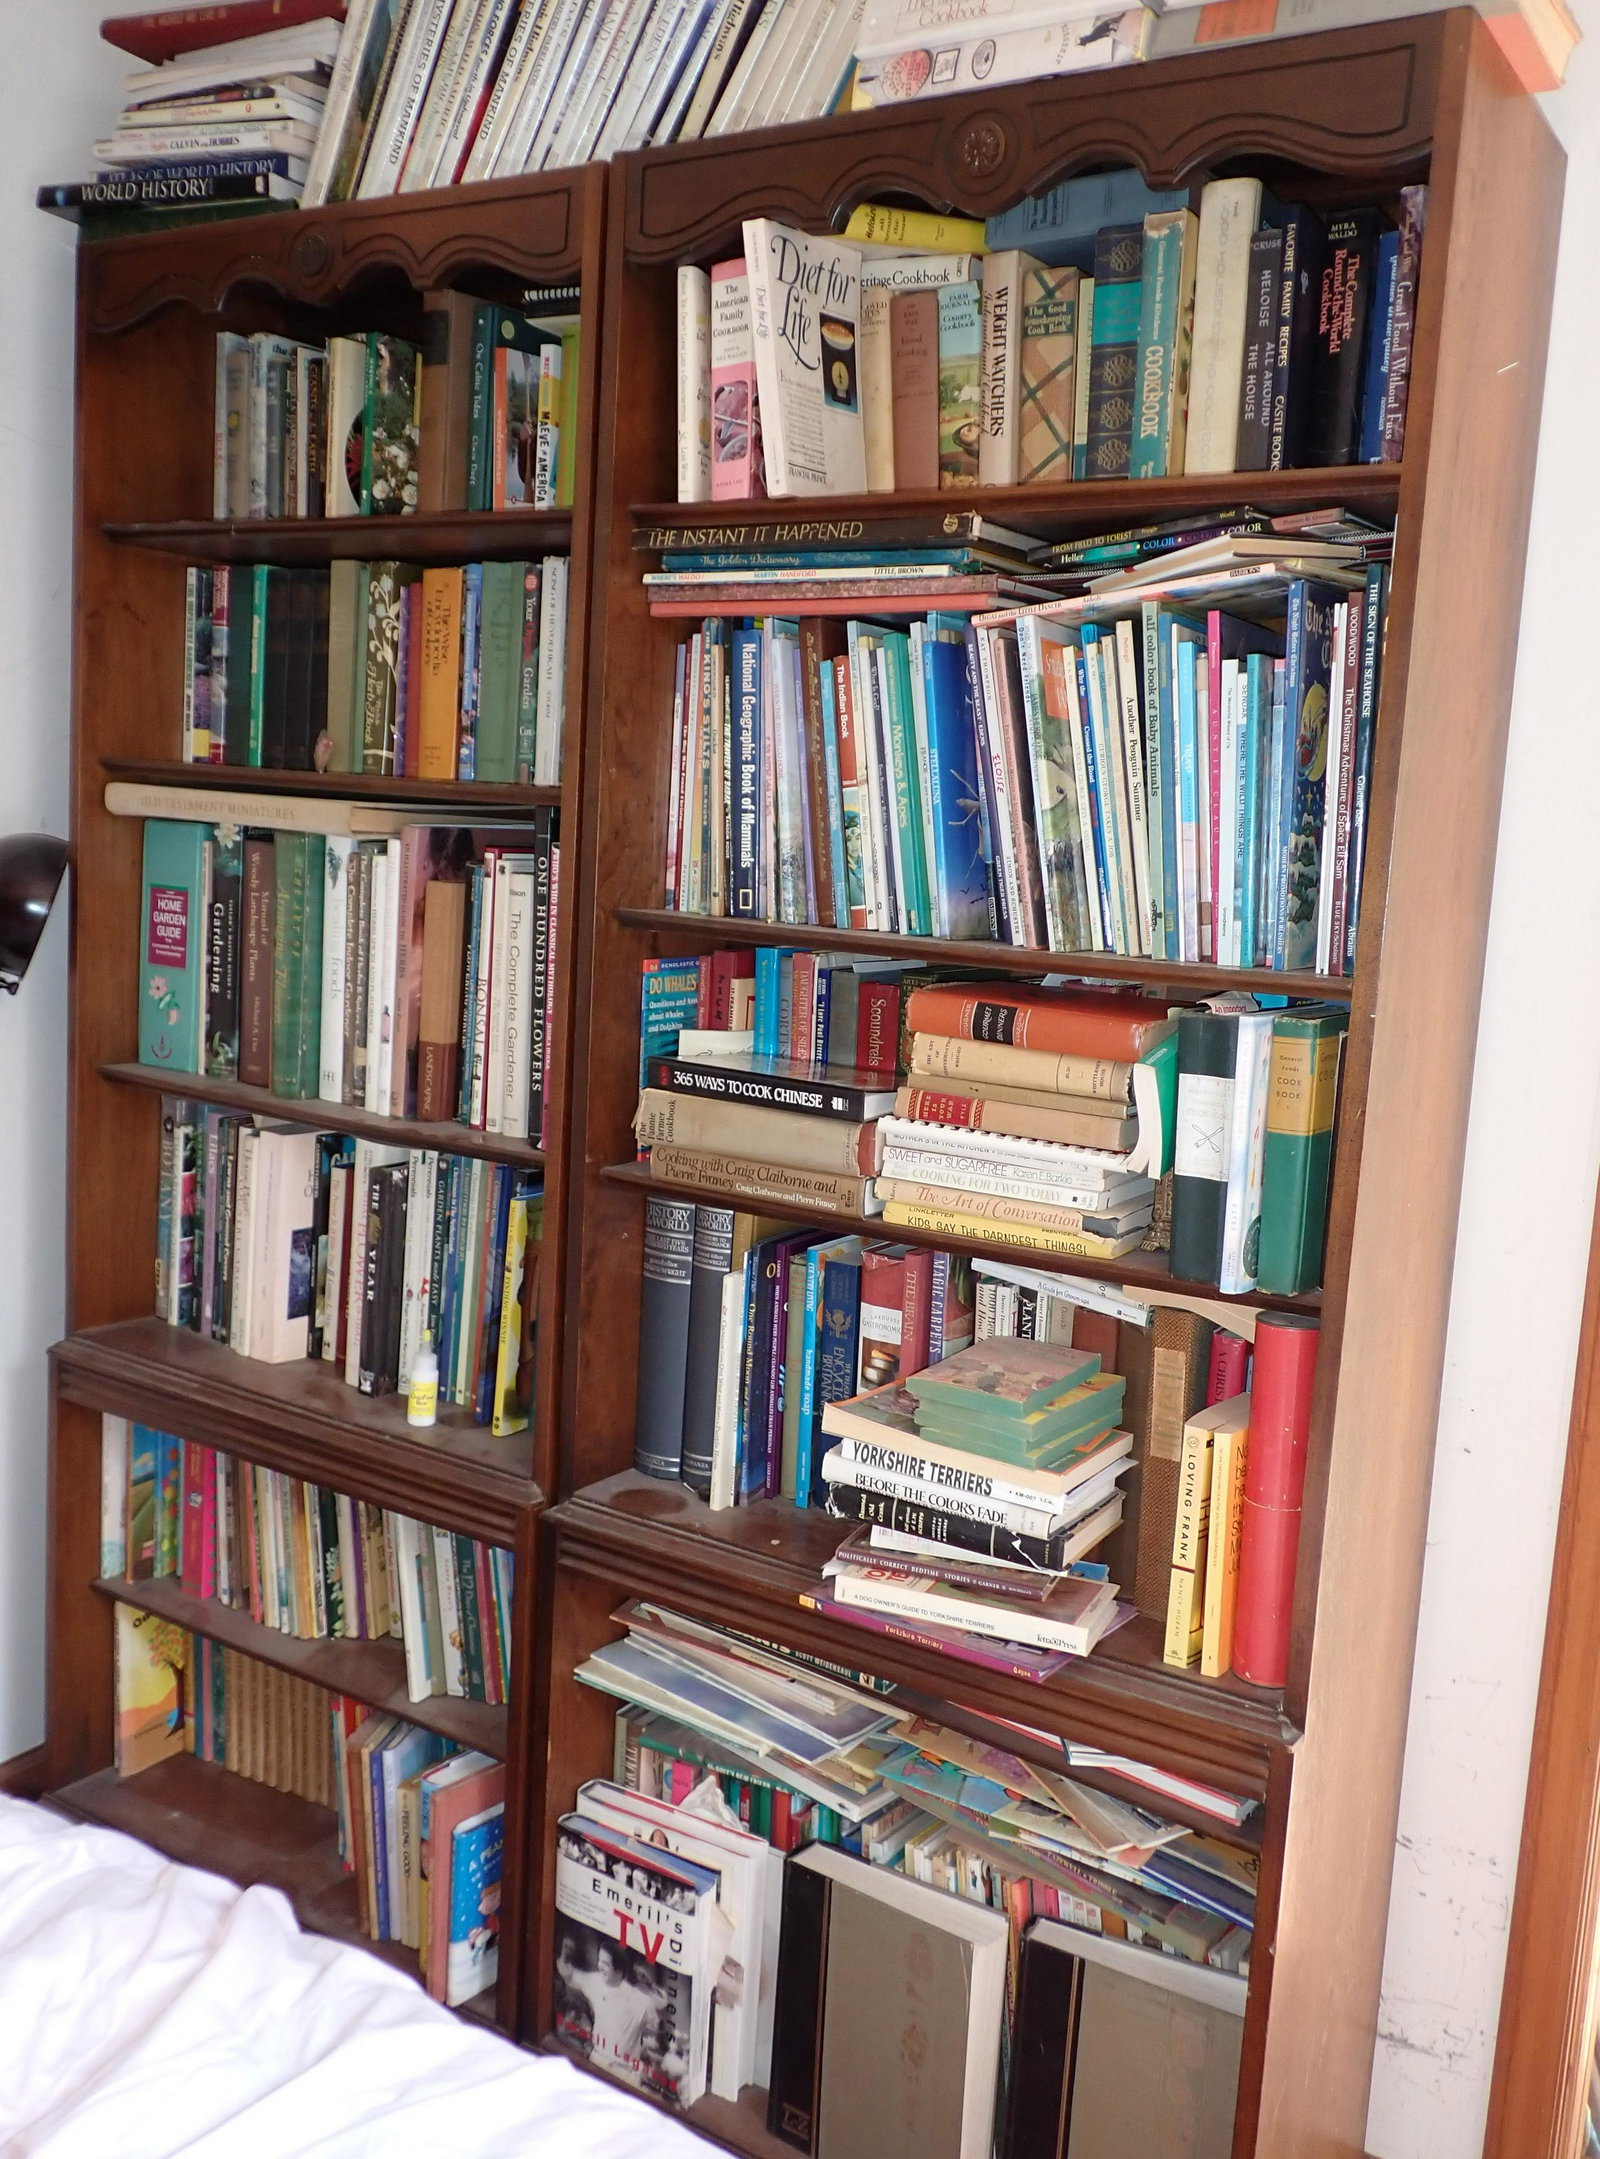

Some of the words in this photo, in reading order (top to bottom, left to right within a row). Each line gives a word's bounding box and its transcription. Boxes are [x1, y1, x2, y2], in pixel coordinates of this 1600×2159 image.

[418, 0, 447, 71] YSTERIES
[412, 73, 421, 92] OF
[390, 97, 415, 164] MANKIND
[81, 182, 136, 201] WORLD
[142, 178, 209, 199] HISTORY
[1328, 230, 1357, 240] WALDO
[1331, 221, 1355, 231] MYRA
[1284, 224, 1296, 272] FAVORITE
[1349, 255, 1360, 276] The
[725, 284, 739, 295] The
[771, 235, 826, 296] Diet
[823, 256, 856, 309] for
[714, 295, 749, 309] American
[720, 309, 744, 322] Family
[1028, 306, 1044, 317] The
[1048, 303, 1067, 314] Good
[1260, 269, 1271, 327] HELOISE
[1282, 281, 1292, 317] FAMILY
[1319, 268, 1333, 335] Cookbook
[1342, 280, 1357, 340] Complete
[1396, 281, 1413, 318] Great
[777, 286, 821, 371] Life
[992, 286, 1008, 354] WEIGHT
[1027, 325, 1045, 335] Cook
[1048, 323, 1067, 333] Book
[1393, 321, 1409, 355] Food
[1248, 343, 1258, 369] THE
[1266, 342, 1275, 365] ALL
[1279, 326, 1289, 367] RECIPES
[990, 355, 1006, 437] WATCHERS
[1141, 346, 1164, 439] COOKBOOK
[1245, 375, 1257, 420] HOUSE
[1262, 370, 1273, 426] AROUND
[1389, 357, 1407, 408] Without
[539, 411, 550, 447] MAEVE
[1274, 395, 1285, 432] CASTLE
[1386, 413, 1401, 440] Fuss
[1271, 433, 1282, 471] BOOKS
[536, 457, 548, 503] AMERICA
[649, 530, 677, 547] THE
[682, 526, 748, 545] INSTANT
[753, 525, 769, 542] IT
[775, 522, 863, 540] HAPPENED
[1052, 542, 1071, 554] FROM
[1073, 538, 1093, 550] FIELD
[1094, 536, 1105, 546] TO
[1106, 531, 1133, 544] FOREST
[700, 554, 715, 566] The
[718, 553, 748, 567] Golden
[750, 552, 800, 567] Dictionary
[1061, 552, 1084, 563] Heller
[1369, 582, 1378, 604] THE
[1146, 614, 1154, 632] all
[1368, 605, 1377, 630] SIGN
[1147, 636, 1156, 661] color
[1367, 631, 1375, 645] OF
[742, 642, 756, 691] National
[837, 665, 845, 680] The
[1365, 647, 1374, 667] THE
[703, 654, 711, 708] KING'S
[1148, 663, 1156, 694] book
[1362, 669, 1372, 718] SEAHORSE
[838, 682, 847, 713] Indian
[1126, 696, 1135, 735] Another
[1149, 697, 1158, 710] of
[702, 712, 710, 769] STILTS
[740, 696, 755, 760] Geographic
[841, 714, 849, 739] Book
[1149, 713, 1159, 741] Baby
[892, 725, 903, 781] Monkeys
[1129, 737, 1139, 778] Penguin
[1150, 743, 1159, 798] Animals
[741, 764, 755, 794] Book
[896, 782, 905, 796] &
[992, 753, 1005, 794] ELOISE
[165, 798, 225, 814] TESTAMENT
[227, 802, 296, 819] MINIATURES
[741, 798, 754, 811] of
[898, 798, 907, 828] Apes
[1132, 781, 1141, 822] Summer
[741, 814, 754, 868] Mammals
[536, 856, 547, 894] ONE
[153, 912, 187, 924] GARDEN
[158, 898, 181, 911] HOME
[157, 925, 181, 938] GUIDE
[509, 910, 522, 940] The
[211, 901, 224, 994] Gardening
[532, 903, 546, 998] HUNDRED
[507, 944, 520, 1023] Complete
[650, 977, 662, 994] DO
[664, 975, 697, 993] WHALES
[475, 978, 488, 1043] BONSAI
[982, 1006, 993, 1041] GOURMET
[995, 1008, 1008, 1042] DINNERS
[530, 1007, 545, 1092] FLOWERS
[868, 998, 886, 1067] Scoundrels
[505, 1025, 518, 1100] Gardener
[674, 1072, 693, 1086] 365
[694, 1077, 725, 1092] WAYS
[727, 1081, 742, 1094] TO
[742, 1084, 772, 1101] COOK
[774, 1088, 823, 1109] CHINESE
[1277, 1077, 1302, 1086] COOK
[656, 1112, 665, 1141] Farmer
[665, 1100, 676, 1143] Cookbook
[410, 1156, 418, 1198] Perennials
[656, 1148, 700, 1170] Cooking
[700, 1158, 724, 1173] with
[725, 1162, 757, 1184] Craig
[757, 1168, 811, 1189] Claiborne
[812, 1180, 837, 1194] and
[370, 1184, 380, 1210] THE
[435, 1180, 445, 1219] GARDEN
[909, 1206, 955, 1218] LINKLETTER
[916, 1186, 942, 1204] The
[943, 1192, 973, 1209] Art
[975, 1197, 990, 1214] of
[992, 1200, 1080, 1228] Conversation
[432, 1224, 443, 1259] PLANTS
[652, 1218, 690, 1232] WORLD
[907, 1216, 932, 1231] KIDS
[936, 1222, 957, 1234] SAY
[960, 1226, 980, 1238] THE
[983, 1231, 1038, 1247] DARNDEST
[1044, 1239, 1088, 1255] THINGS!
[367, 1250, 377, 1301] YEAR
[502, 1273, 511, 1310] FINDING
[905, 1271, 917, 1298] THE
[932, 1259, 945, 1298] MAGIC
[499, 1311, 508, 1344] WINNIE
[904, 1300, 915, 1341] BRAIN
[929, 1301, 944, 1354] CARPETS
[853, 1441, 925, 1479] YORKSHIRE
[929, 1463, 993, 1496] TERRIERS
[1184, 1454, 1196, 1507] LOVING
[855, 1472, 899, 1496] BEFORE
[902, 1487, 926, 1502] THE
[928, 1492, 974, 1517] COLORS
[977, 1505, 1007, 1526] FADE
[1179, 1514, 1191, 1561] FRANK
[838, 1551, 876, 1566] POLITICALLY
[880, 1559, 908, 1571] CORRECT
[911, 1566, 939, 1577] BEDTIME
[945, 1573, 970, 1584] STORIES
[977, 1579, 1000, 1589] GARNER
[885, 1625, 915, 1641] Yorkshire
[917, 1635, 943, 1650] Terriers
[593, 1880, 682, 1935] Emeril's
[614, 1909, 664, 1964] TV
